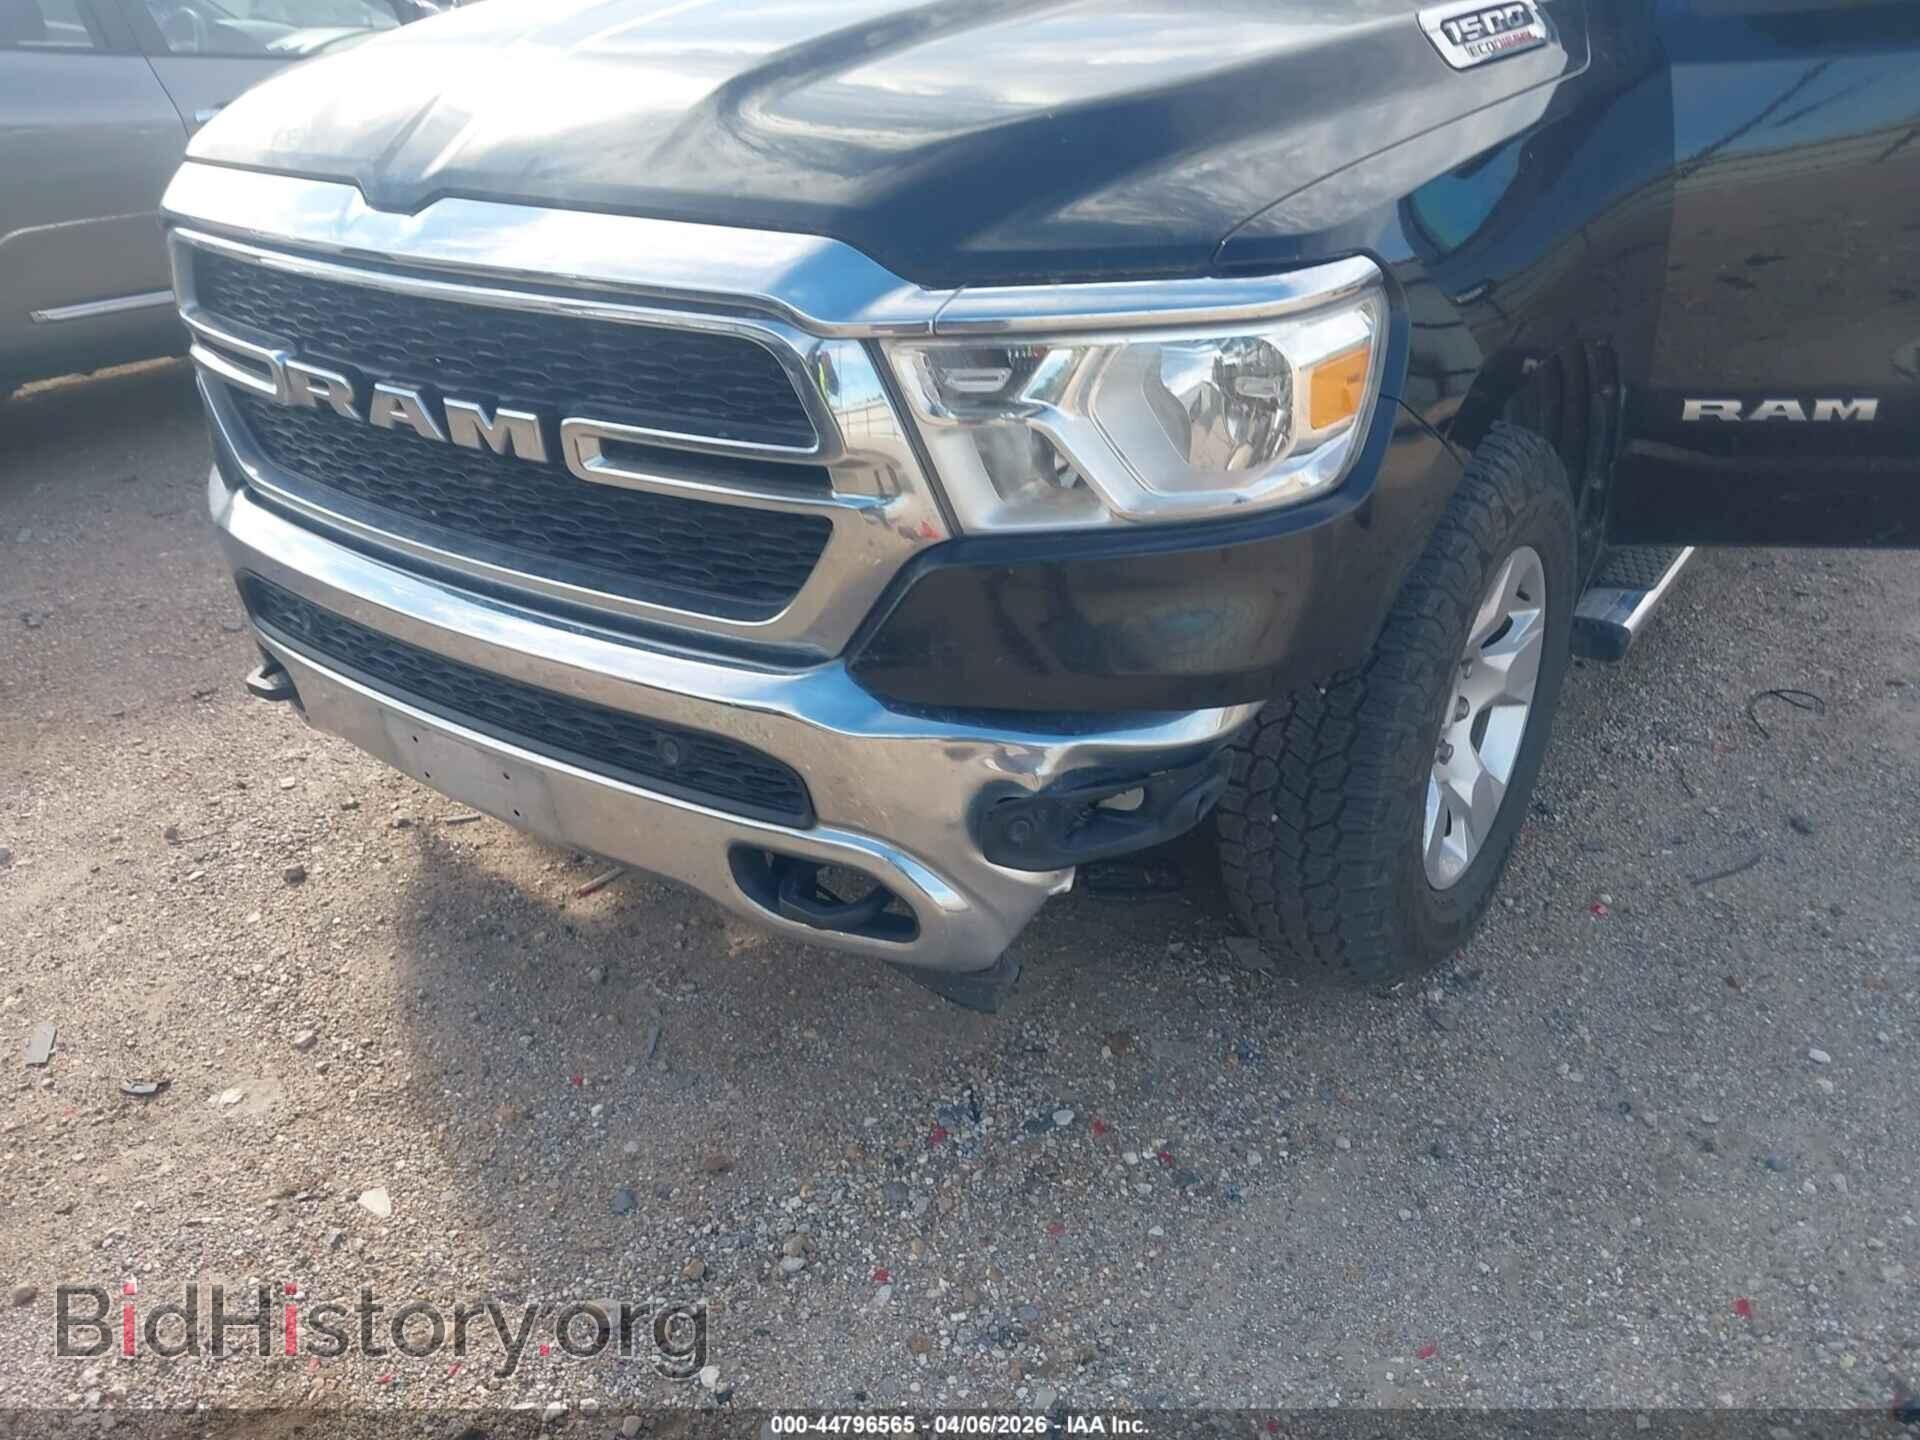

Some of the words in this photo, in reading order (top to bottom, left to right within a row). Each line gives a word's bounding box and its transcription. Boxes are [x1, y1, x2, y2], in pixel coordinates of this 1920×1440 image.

[1442, 4, 1525, 44] 1500
[282, 357, 548, 463] RAM
[1682, 398, 1879, 422] RAM
